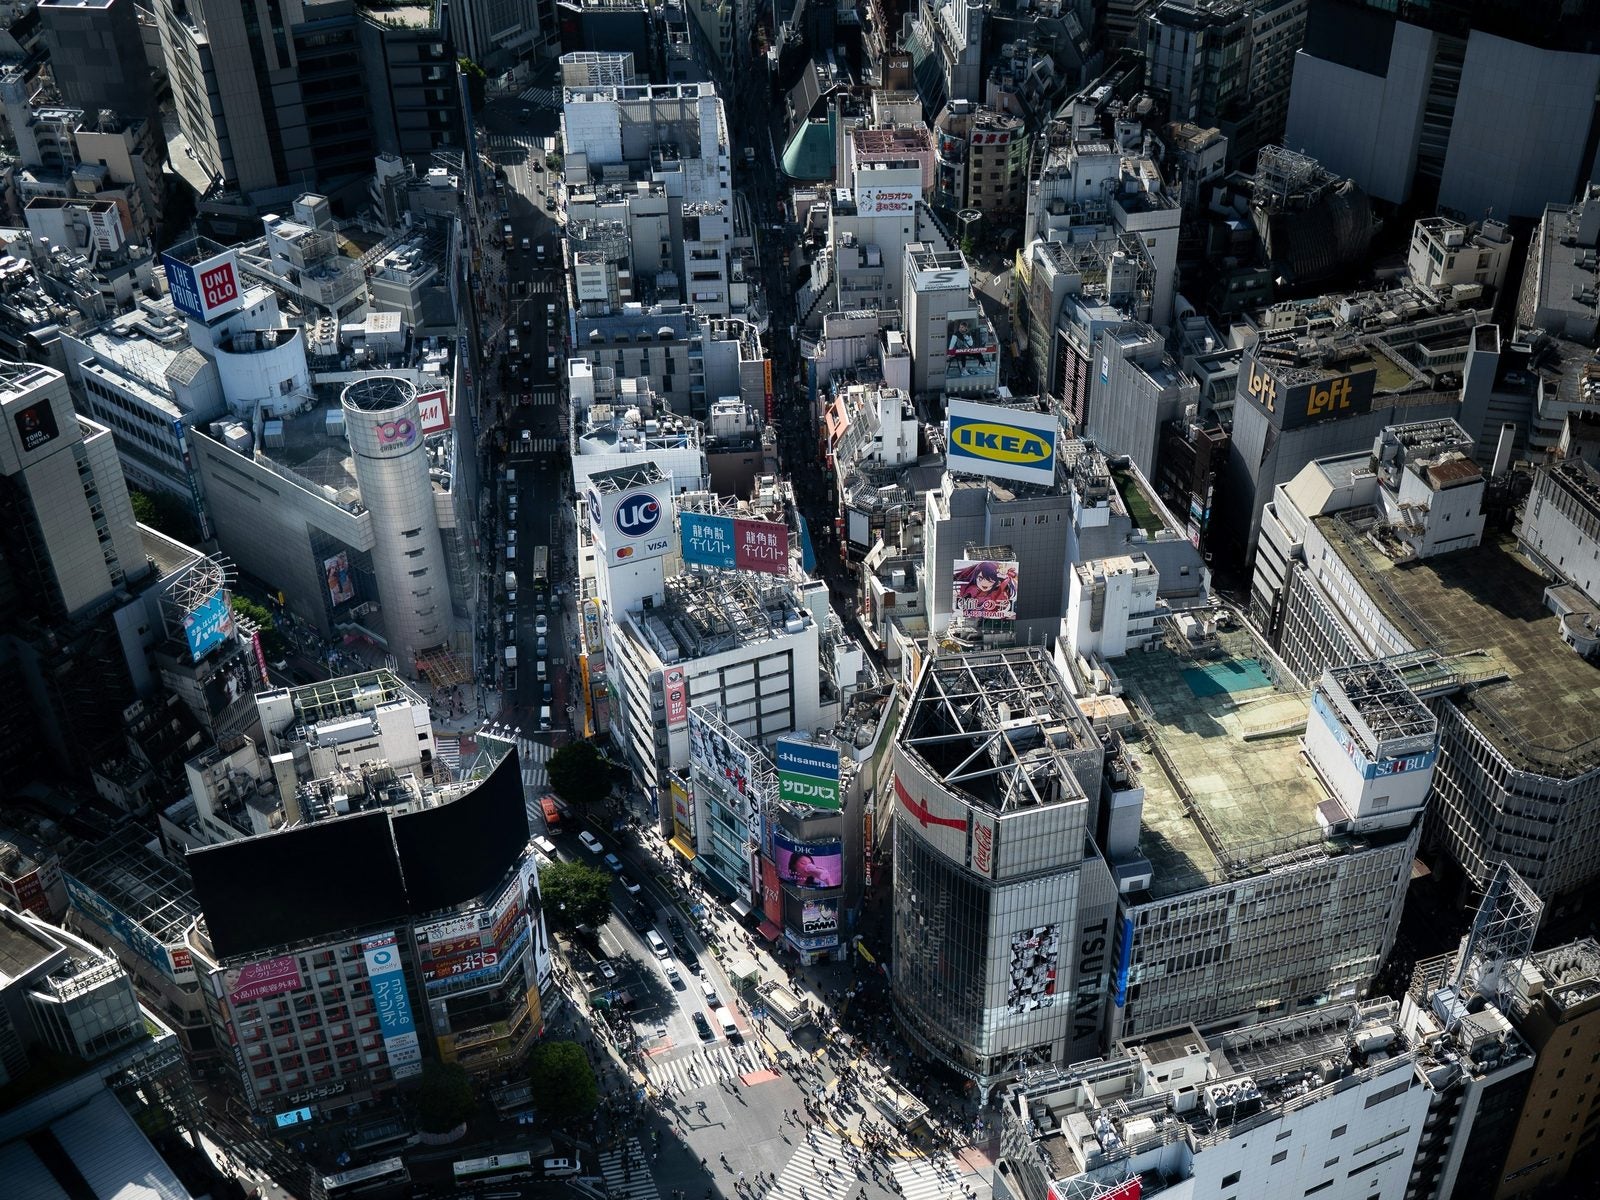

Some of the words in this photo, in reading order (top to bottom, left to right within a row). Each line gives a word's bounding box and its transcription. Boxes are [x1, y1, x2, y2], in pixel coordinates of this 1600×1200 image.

[171, 264, 191, 290] THE
[205, 269, 228, 289] UNI
[170, 282, 201, 313] PRIME
[208, 284, 233, 304] QLO
[26, 430, 43, 442] TOHO
[28, 433, 50, 448] CINEMAS
[374, 419, 416, 447] 109
[960, 429, 1044, 457] IKEA
[692, 524, 724, 541] 龍角散
[745, 531, 777, 547] 龍角散
[647, 541, 668, 551] VISA
[779, 752, 838, 770] Hisamitsu
[1376, 756, 1426, 776] SEIBU
[782, 779, 836, 801] サロンパス
[794, 845, 815, 855] DHC
[451, 960, 480, 974] ガスト
[240, 979, 297, 999] 品川美容外科
[1072, 918, 1108, 1042] TSUTAYA
[375, 981, 397, 1027] アイシティ
[288, 1081, 347, 1104] サンドラッグ
